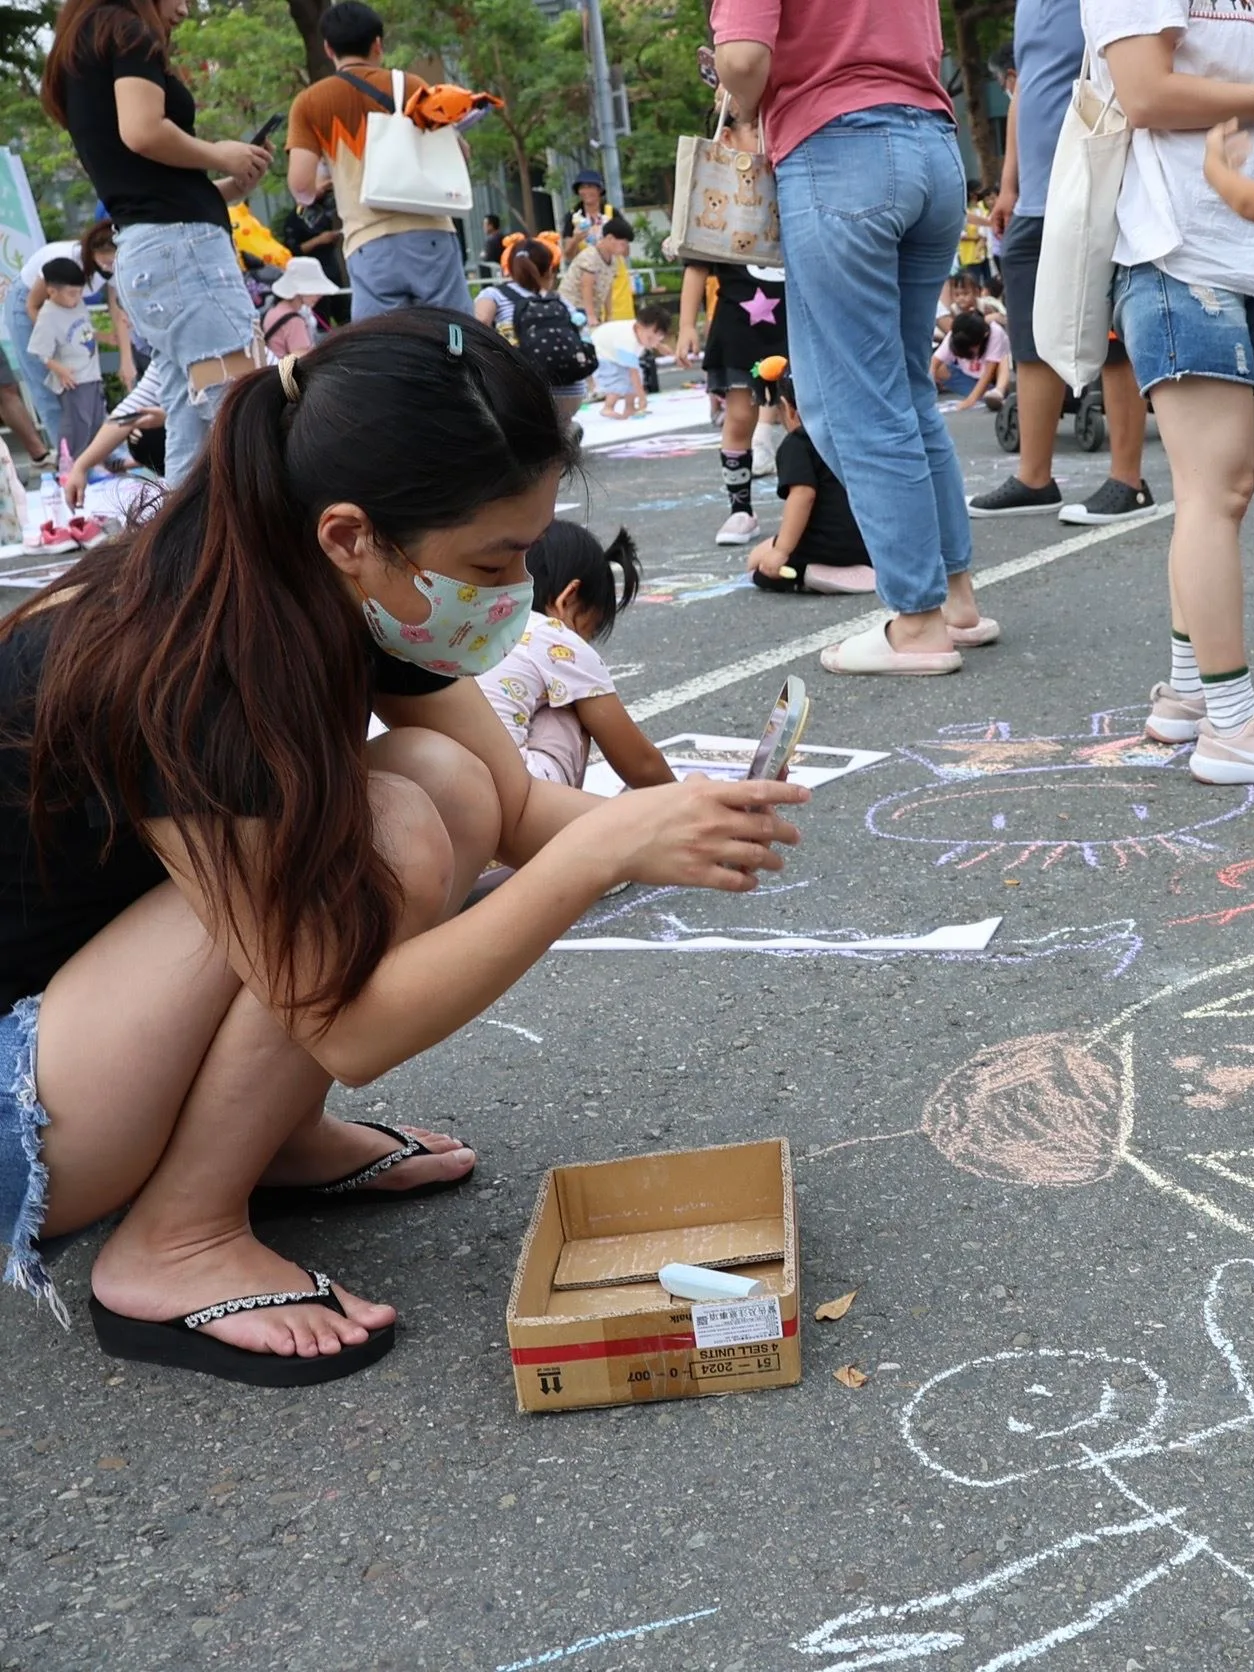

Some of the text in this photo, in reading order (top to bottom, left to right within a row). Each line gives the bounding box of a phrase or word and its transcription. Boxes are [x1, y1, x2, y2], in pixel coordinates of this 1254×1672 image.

[669, 1313, 692, 1324] halk
[699, 1343, 779, 1359] 4 SELL UNITS
[701, 1362, 733, 1375] 2024
[757, 1357, 771, 1369] 51
[627, 1371, 650, 1382] 007
